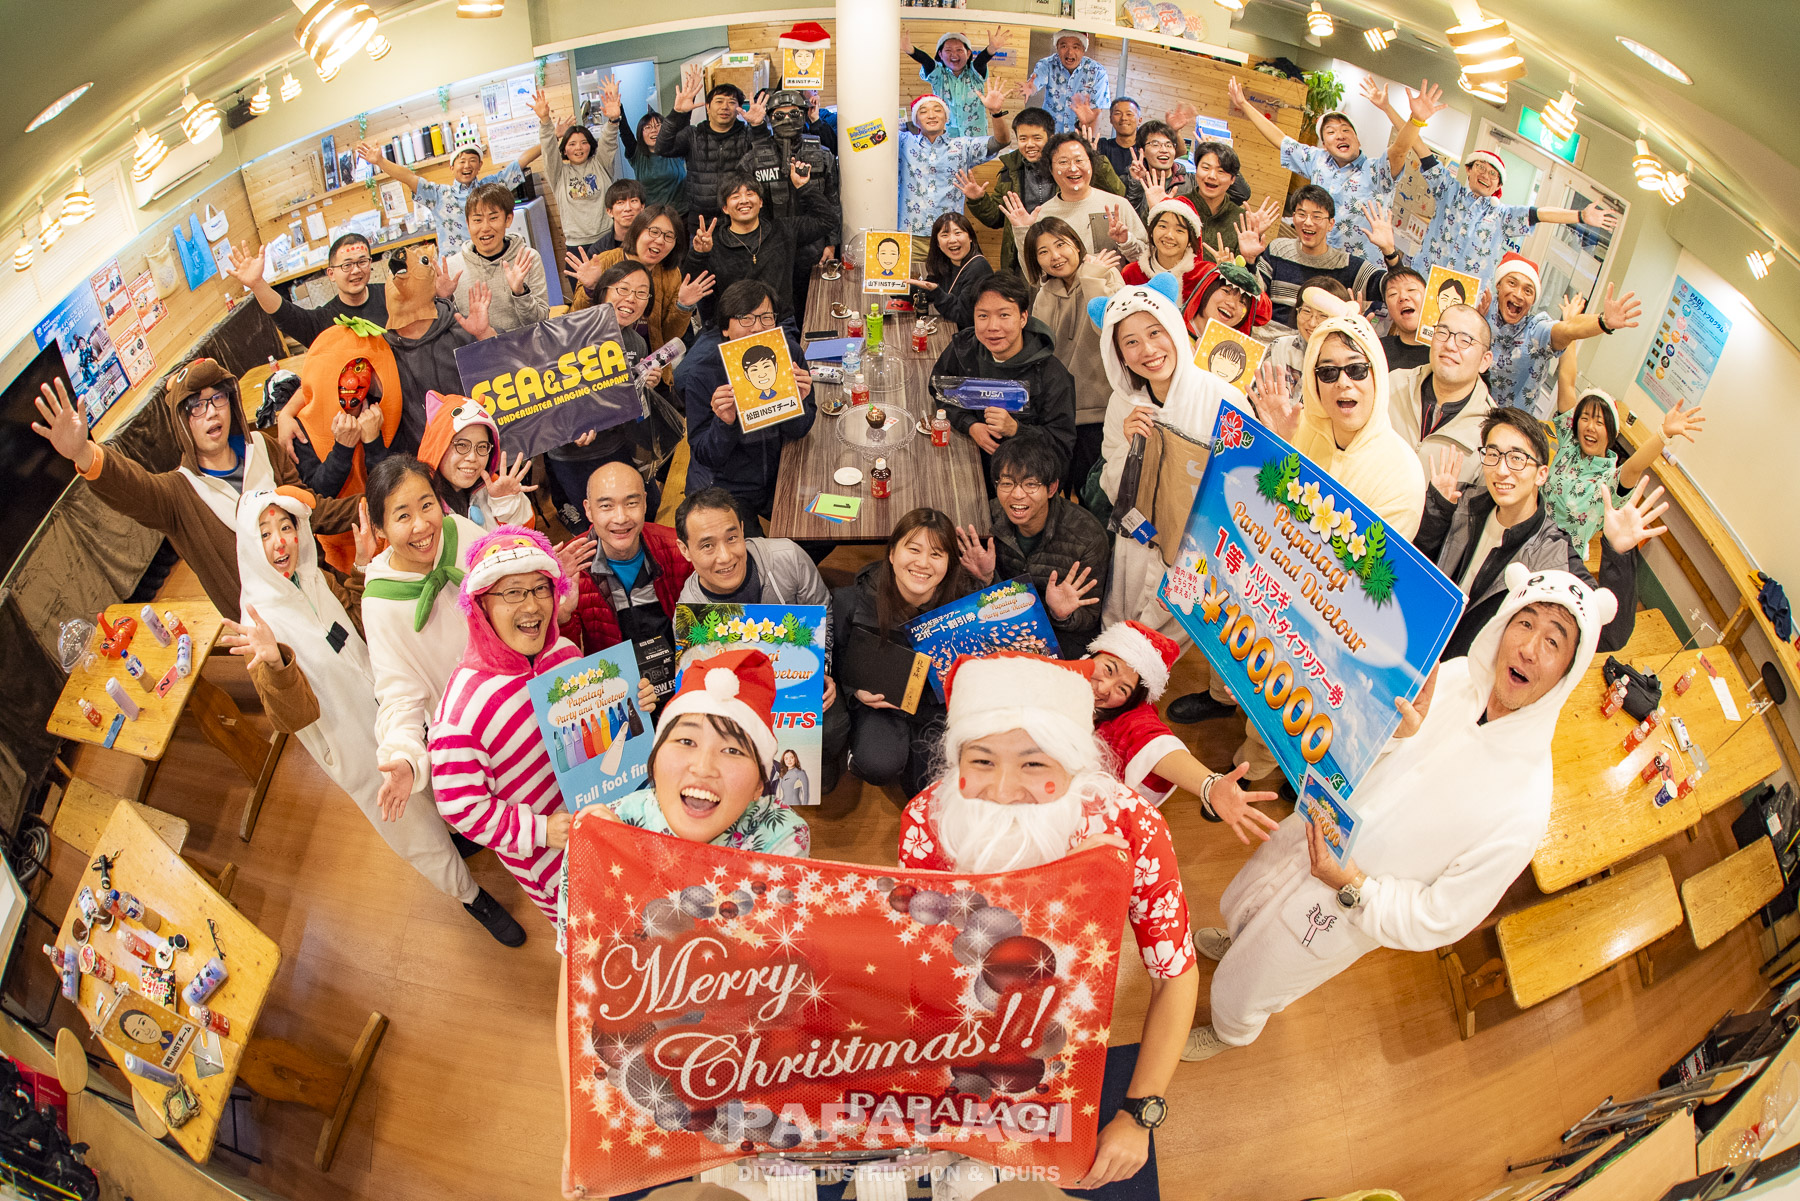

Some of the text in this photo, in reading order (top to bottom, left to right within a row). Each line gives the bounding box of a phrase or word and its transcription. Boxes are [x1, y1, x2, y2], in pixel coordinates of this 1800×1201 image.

[755, 166, 780, 182] SWAT
[1690, 292, 1705, 307] PADI
[470, 340, 628, 417] SEA&SEA
[979, 390, 1004, 398] TUSA
[497, 400, 553, 426] UNDERWATER
[553, 386, 591, 406] IMAGING
[591, 373, 630, 392] COMPANY
[746, 399, 797, 421] 松田INSTチーム
[1213, 526, 1246, 576] 1等
[1272, 503, 1353, 594] Papalagi
[1172, 574, 1198, 594] どちらでも
[1232, 501, 1367, 655] Party and Divetour
[1250, 562, 1293, 610] パパラギ
[990, 599, 1018, 611] Papalagi
[914, 612, 977, 642] 2ボート割引券
[1244, 580, 1345, 708] リゾートダイブツアー券
[654, 681, 669, 695] SW
[775, 669, 814, 681] vetour
[1201, 575, 1334, 765] ¥100,000
[555, 690, 627, 726] Party and Divetour
[566, 685, 605, 709] Papalagi
[575, 785, 600, 809] Full
[601, 770, 629, 794] foot
[600, 936, 804, 1023] Merry
[653, 985, 1057, 1102] Christmas!!
[849, 1092, 1060, 1134] PAPALAGI
